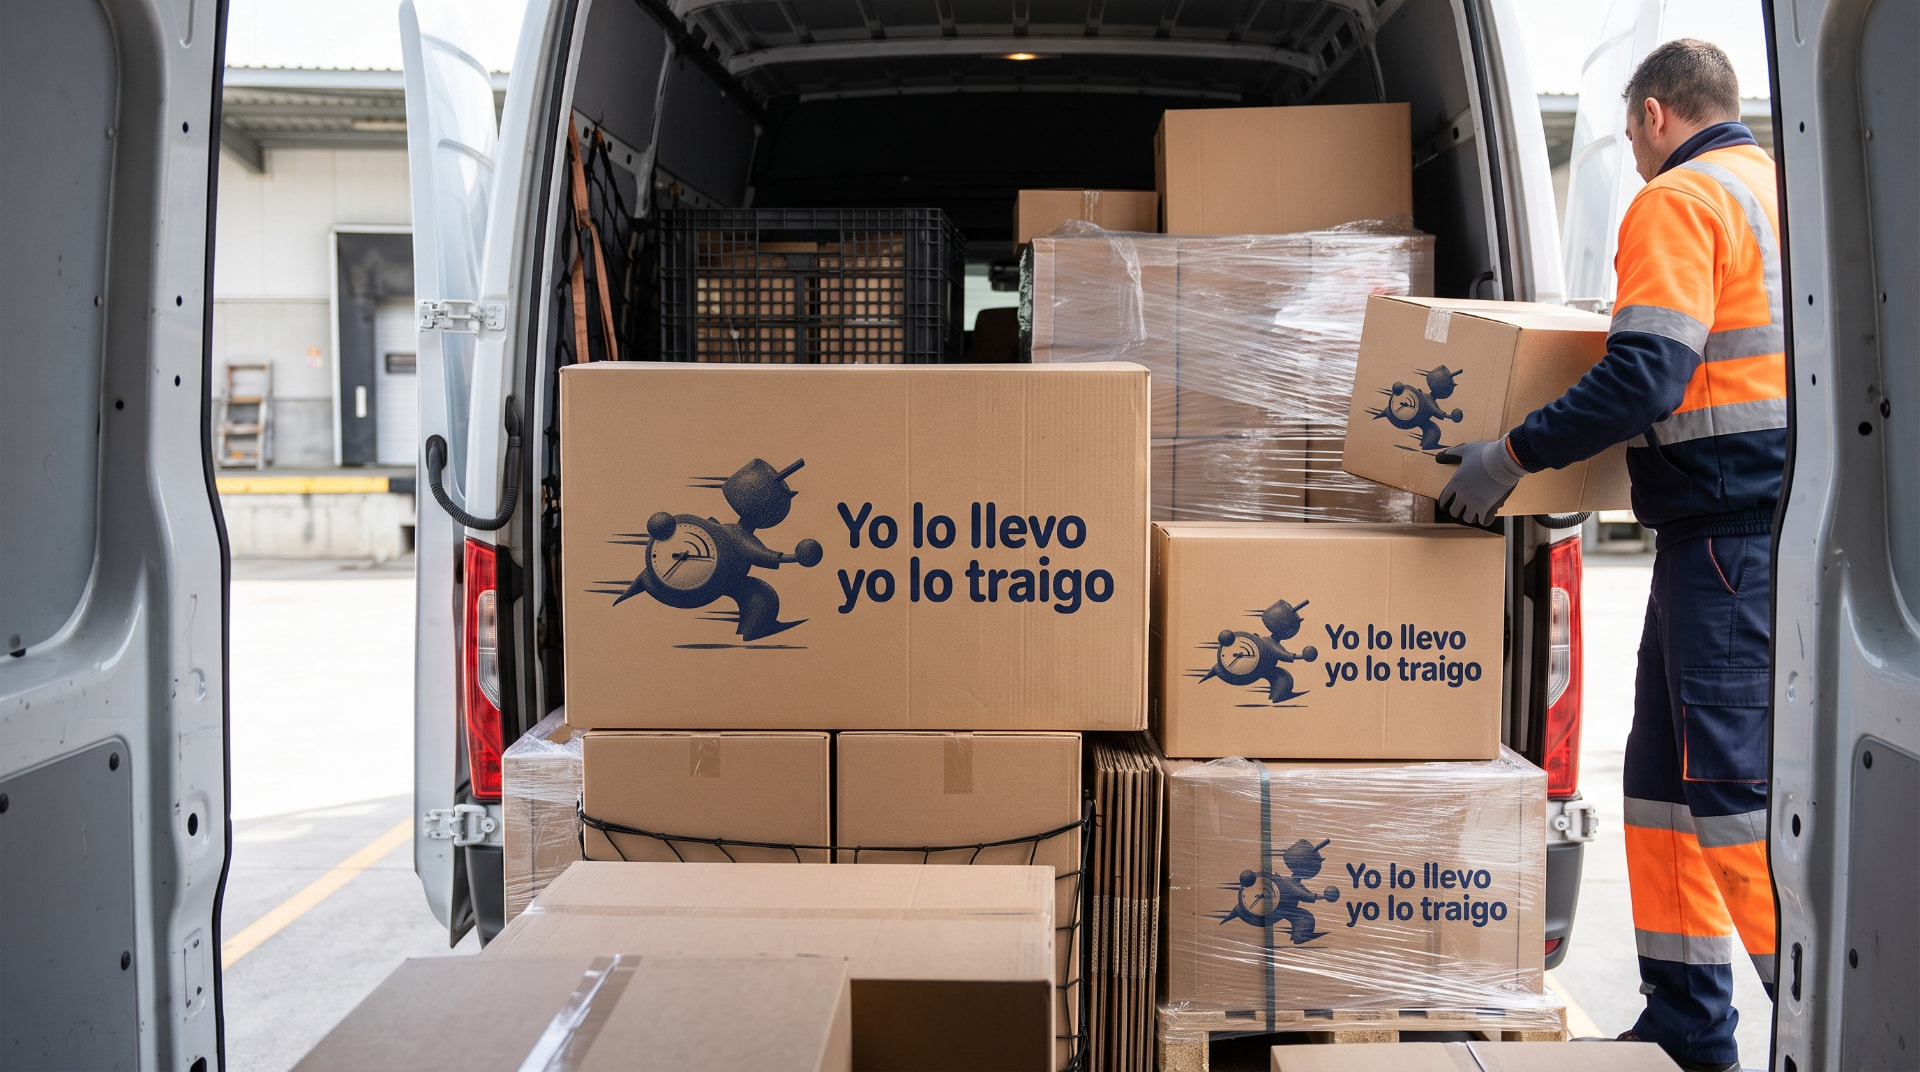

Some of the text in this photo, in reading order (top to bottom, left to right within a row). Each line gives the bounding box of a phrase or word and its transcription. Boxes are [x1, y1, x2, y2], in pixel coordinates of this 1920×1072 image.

[837, 502, 1086, 549] Yo lo llevo
[837, 556, 1114, 614] yo lo traigo
[1325, 624, 1466, 650] Yo lo llevo
[1325, 655, 1482, 688] yo lo traigo
[1346, 862, 1492, 889] Yo lo llevo
[1346, 894, 1508, 928] yo lo traigo
